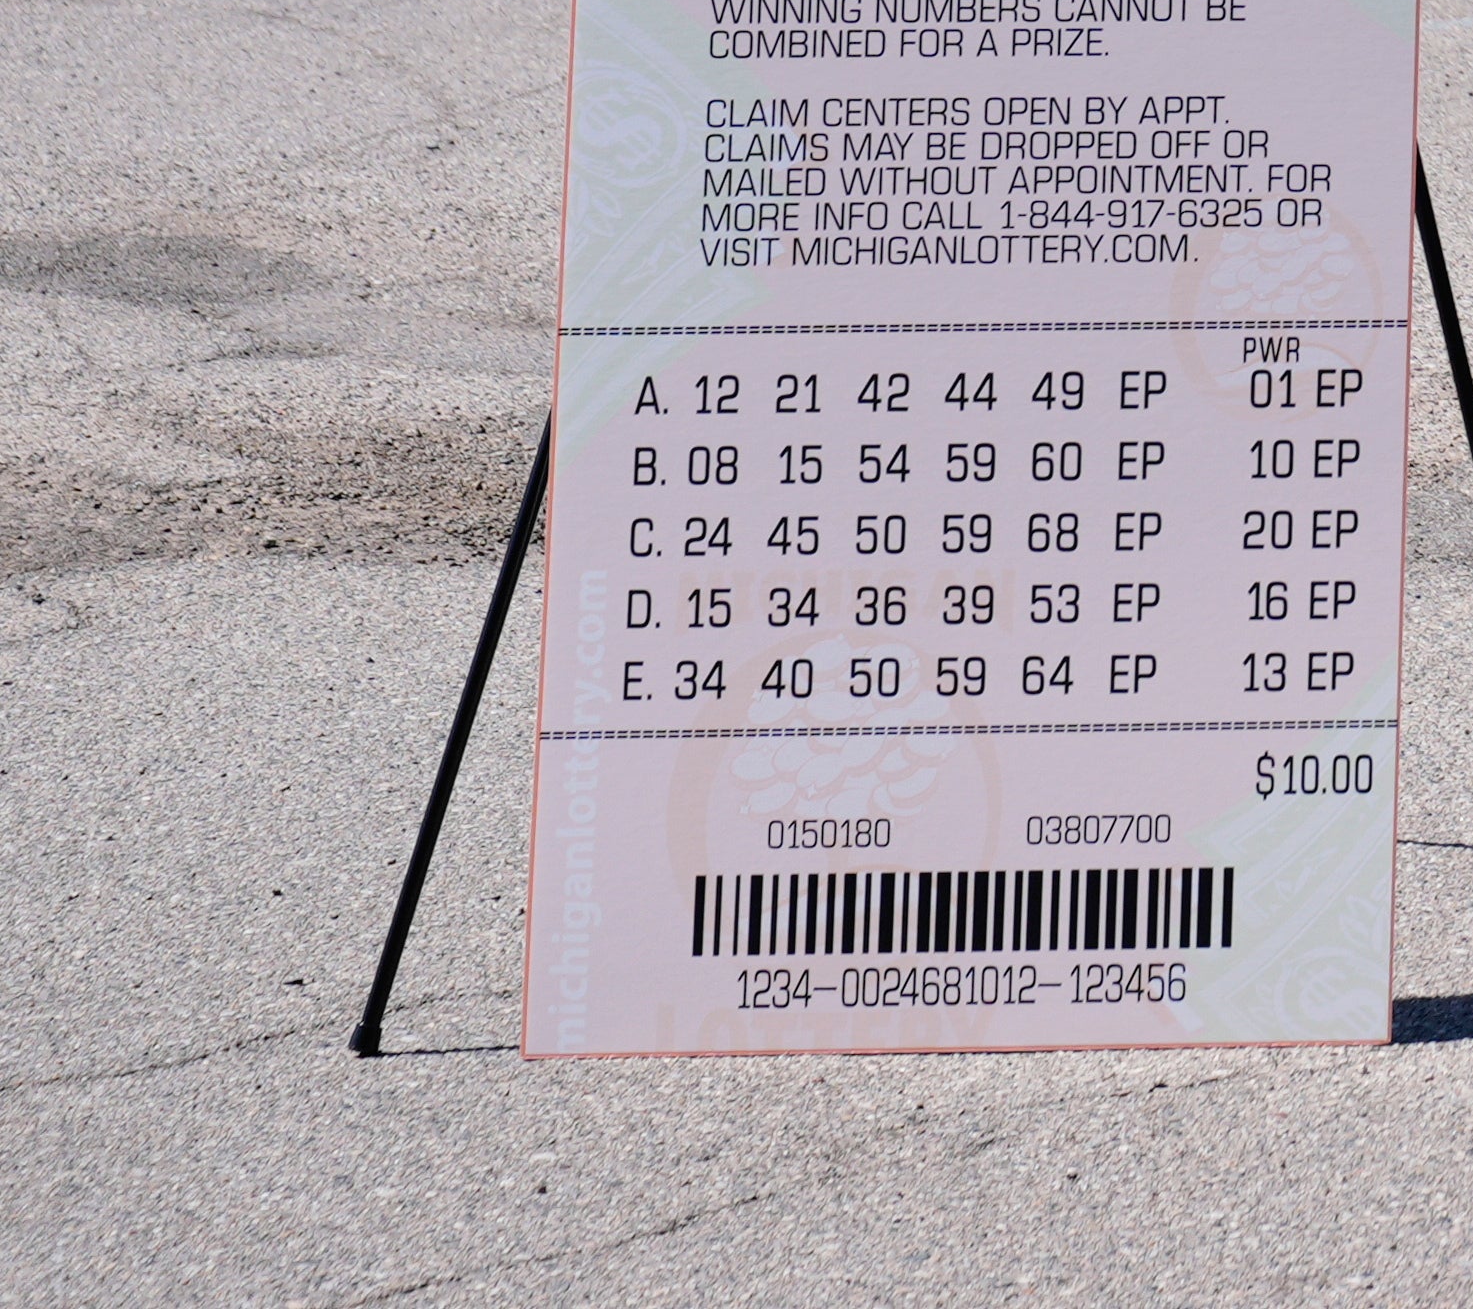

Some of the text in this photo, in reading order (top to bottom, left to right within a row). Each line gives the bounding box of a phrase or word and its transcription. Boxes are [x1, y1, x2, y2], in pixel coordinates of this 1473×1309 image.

[701, 198, 1322, 232] MORE INFO CALL 1-844-917-6325 OR
[634, 368, 1363, 415] A. 12 21 42 44 49 EP 01 EP
[1255, 750, 1373, 801] $10.00
[767, 814, 1171, 850] 0150180 03807700
[737, 962, 1186, 1009] 1234-0024681012-123456
